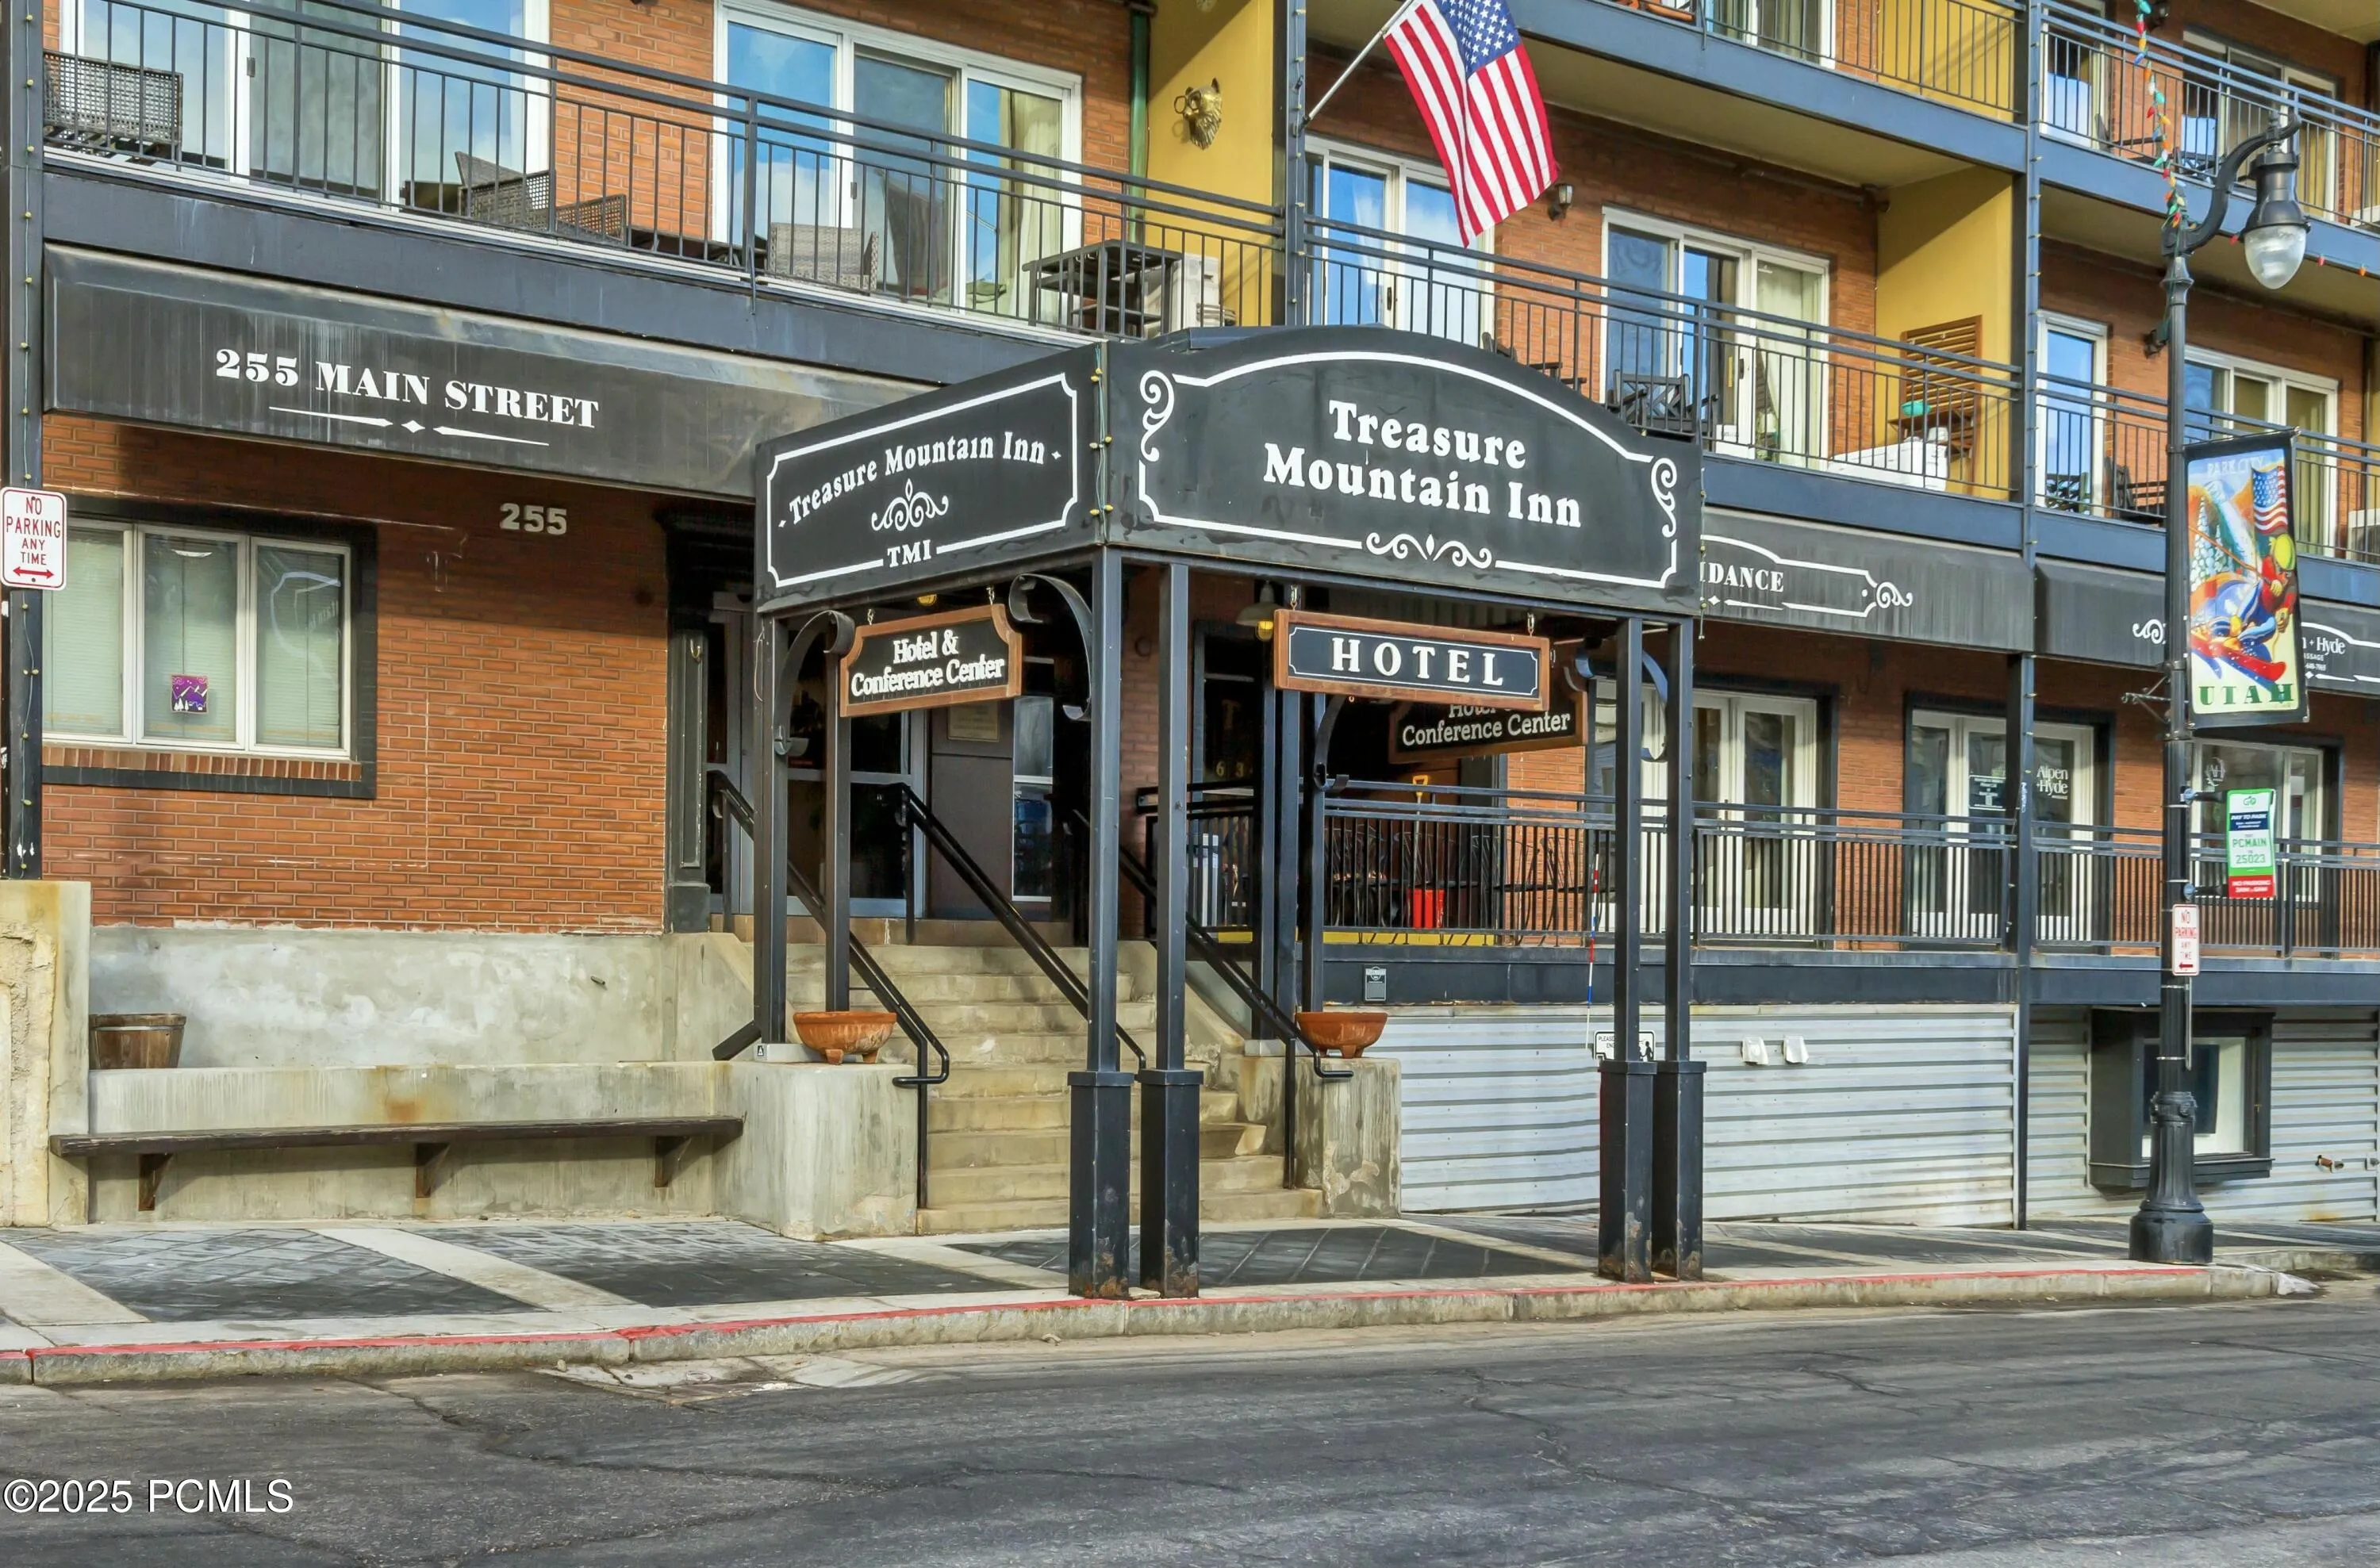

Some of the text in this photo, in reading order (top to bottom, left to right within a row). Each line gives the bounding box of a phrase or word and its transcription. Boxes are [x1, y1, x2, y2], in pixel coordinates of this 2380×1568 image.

[216, 348, 599, 428] 255 MAIN STREET
[1330, 400, 1526, 468] Treasure
[789, 431, 1045, 526] Treasure Mountain Inn
[1264, 443, 1582, 527] Mountain Inn
[25, 497, 42, 515] NO
[499, 503, 567, 535] 255
[6, 516, 60, 539] PARKING
[20, 551, 47, 565] TIME
[21, 538, 45, 550] ANY
[888, 539, 932, 569] TMI
[892, 629, 959, 665] Hotel &
[2317, 637, 2346, 655] Hyde
[850, 654, 1005, 696] Conference Center
[1331, 637, 1504, 686] HOTEL
[2198, 684, 2294, 705] UTAH
[1402, 711, 1572, 746] Conference Center
[2036, 765, 2068, 780] Alpen
[2233, 838, 2267, 848] PCMAIN
[2236, 854, 2266, 864] 25023
